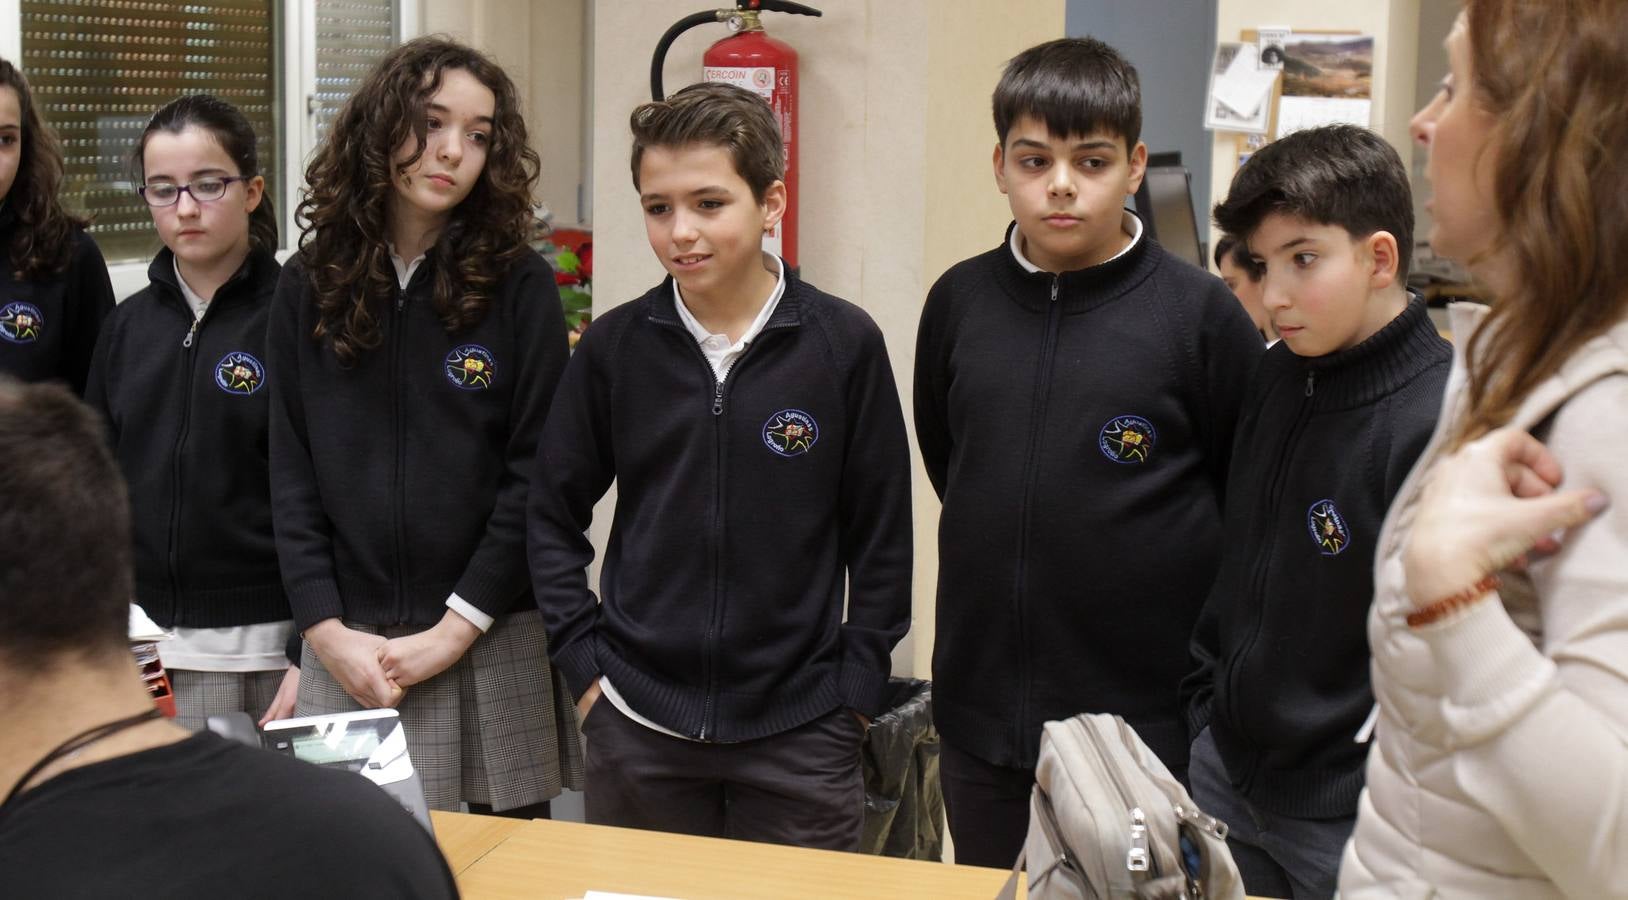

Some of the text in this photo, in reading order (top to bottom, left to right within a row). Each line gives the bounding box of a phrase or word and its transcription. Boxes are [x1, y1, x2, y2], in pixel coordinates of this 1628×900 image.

[705, 69, 747, 80] CERCOIN
[785, 411, 814, 432] Agustinas
[766, 431, 785, 452] Logroño
